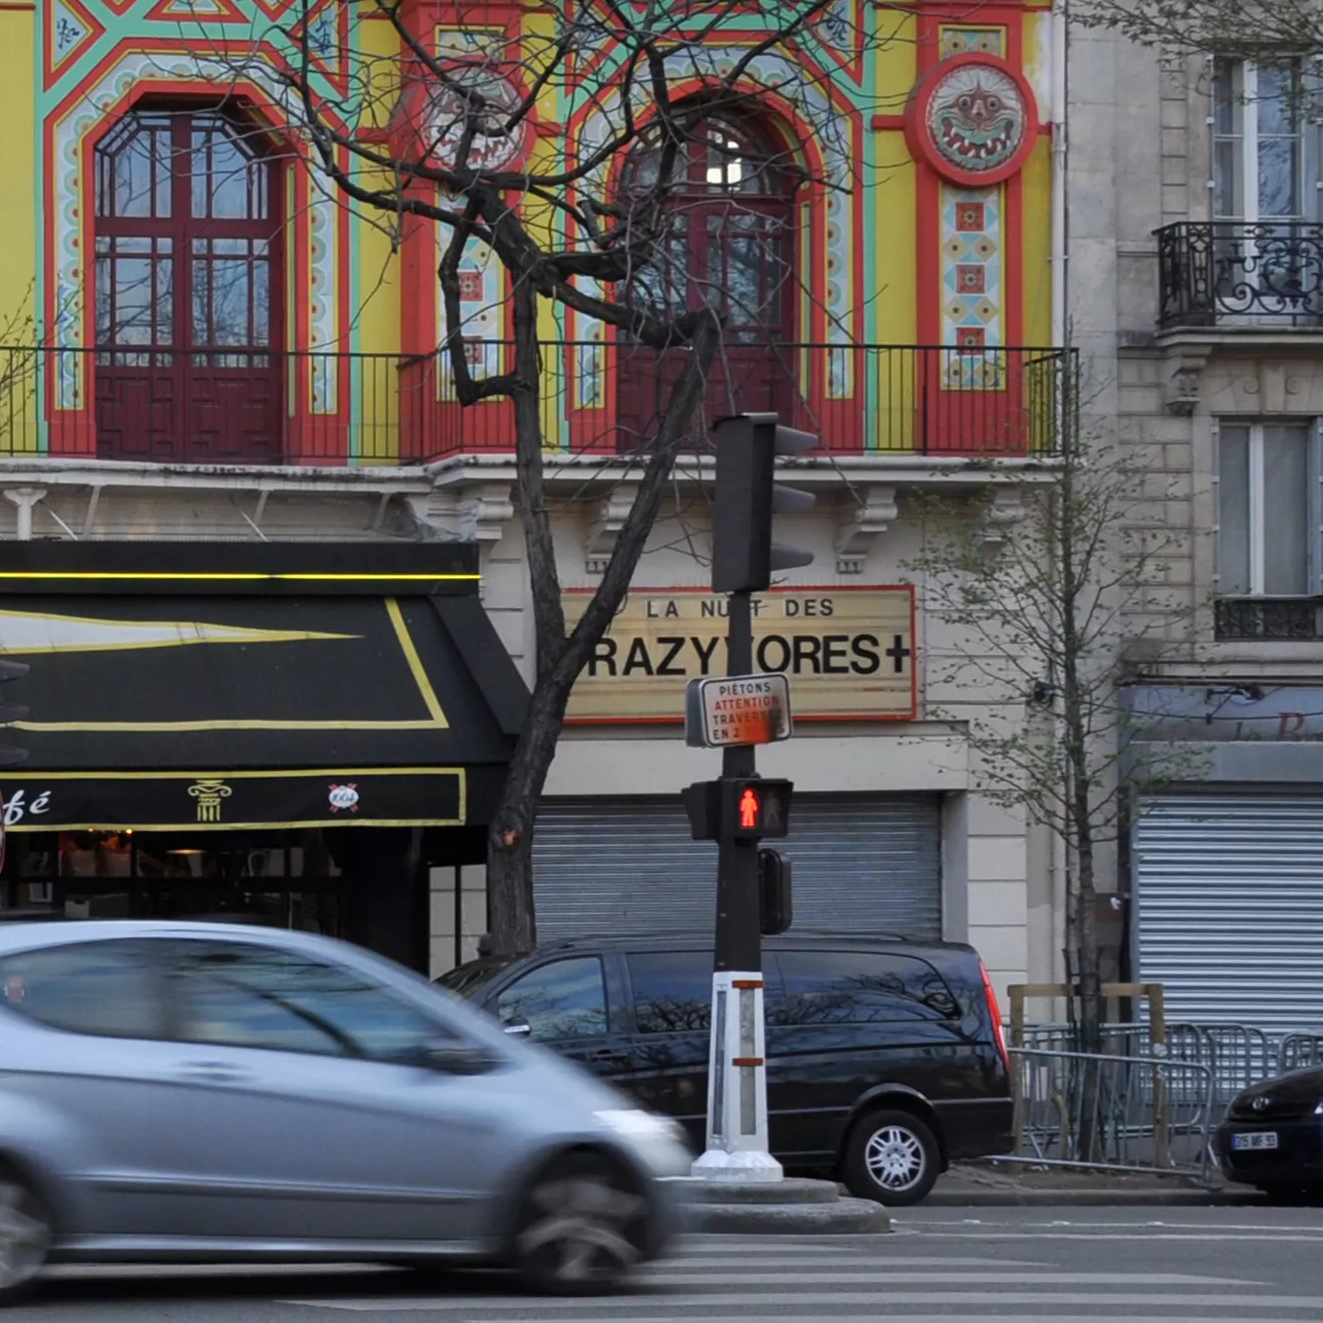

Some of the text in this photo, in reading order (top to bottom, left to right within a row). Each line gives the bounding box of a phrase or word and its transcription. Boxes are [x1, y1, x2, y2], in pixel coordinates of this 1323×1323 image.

[646, 598, 834, 618] LA NUT DES
[719, 681, 772, 696] PIÉTONS
[715, 695, 780, 712] ATTENTION
[713, 728, 729, 740] EN
[733, 727, 741, 739] 2
